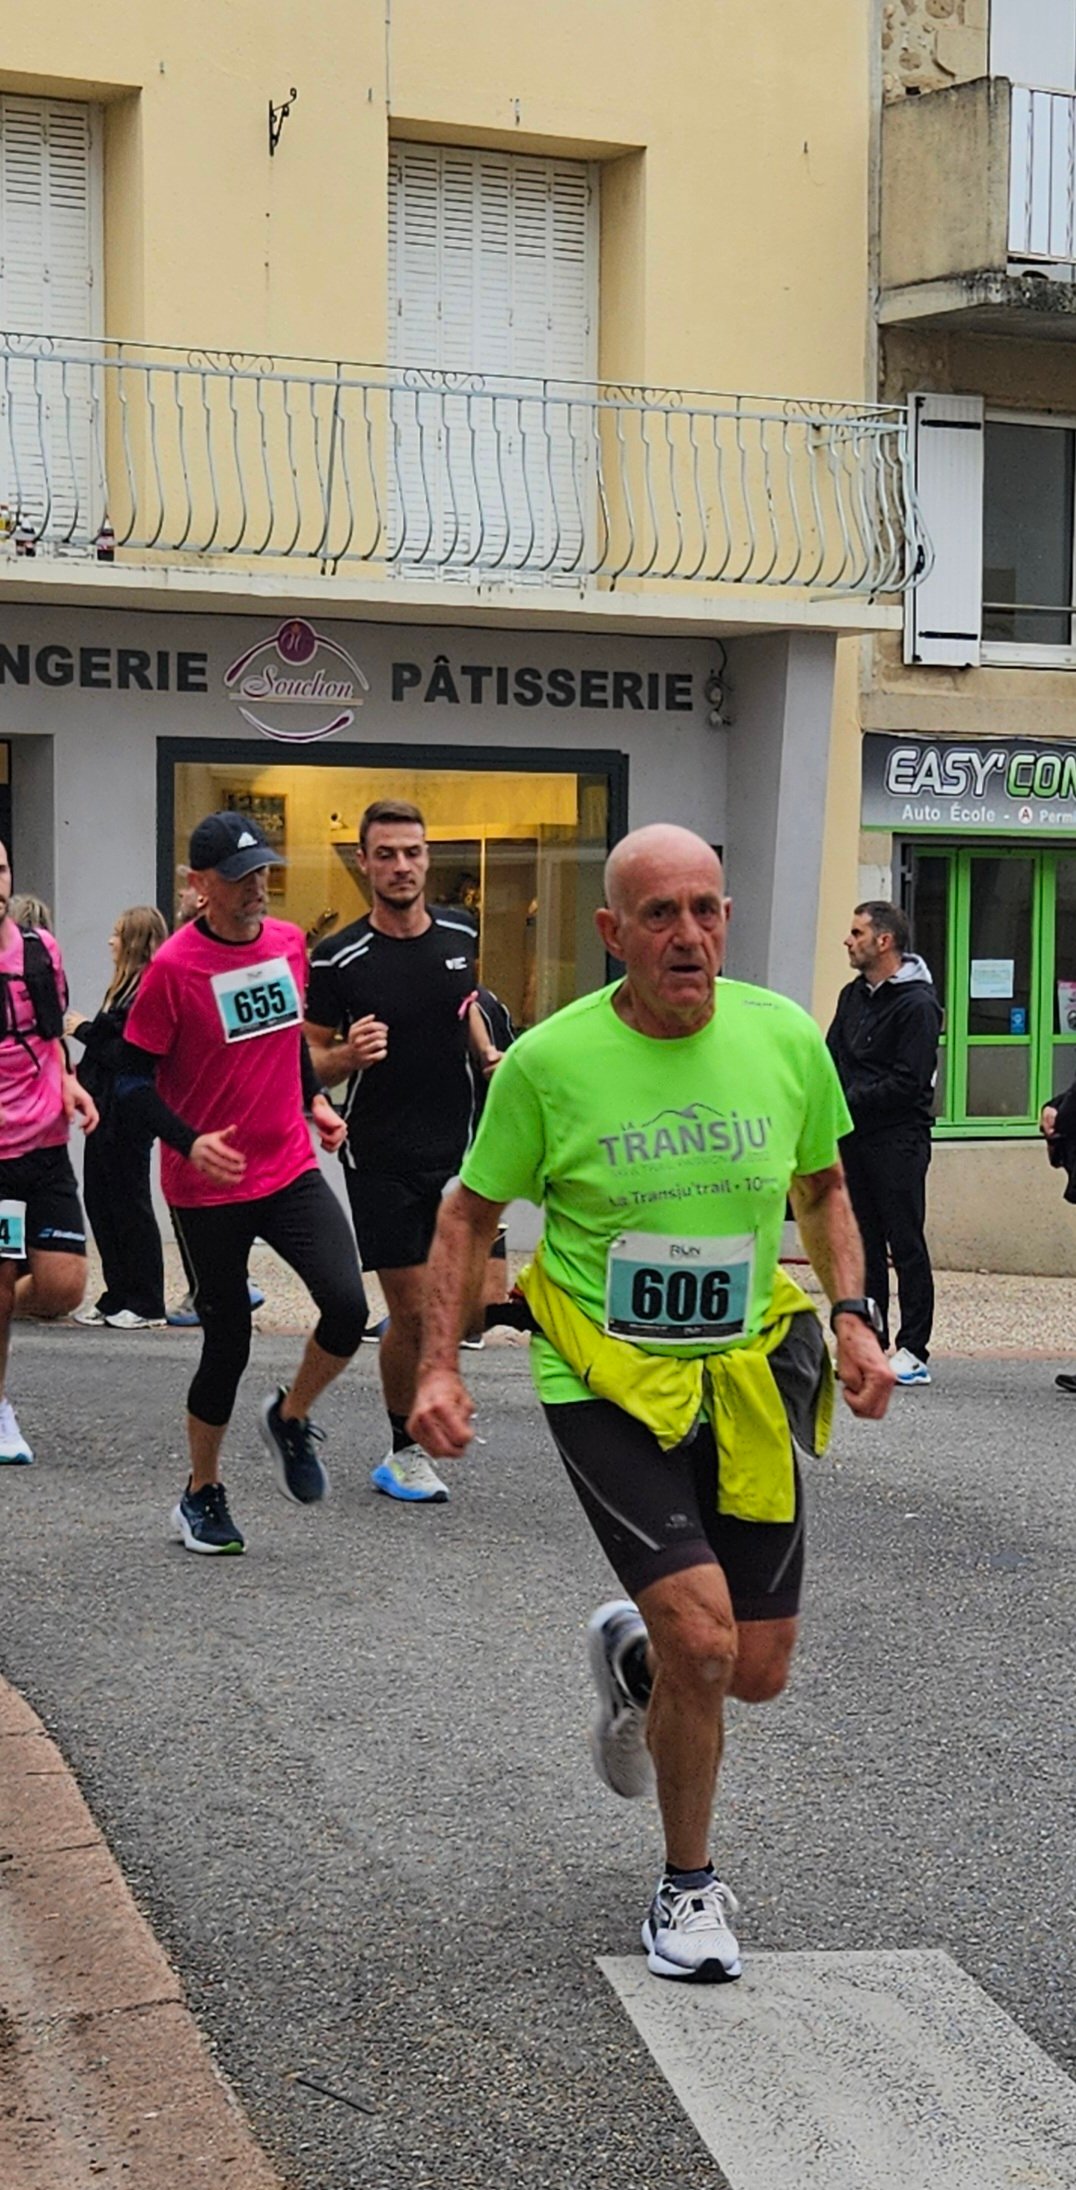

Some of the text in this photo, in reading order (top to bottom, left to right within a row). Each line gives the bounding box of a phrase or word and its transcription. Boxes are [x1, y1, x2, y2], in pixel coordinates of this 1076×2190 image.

[0, 643, 208, 692] NGERIE
[242, 666, 352, 699] Souchon
[391, 654, 693, 711] PÂTISSERIE
[902, 804, 941, 821] Auto
[950, 802, 996, 823] École
[233, 981, 287, 1024] 655
[608, 1195, 628, 1208] La
[632, 1268, 731, 1322] 606
